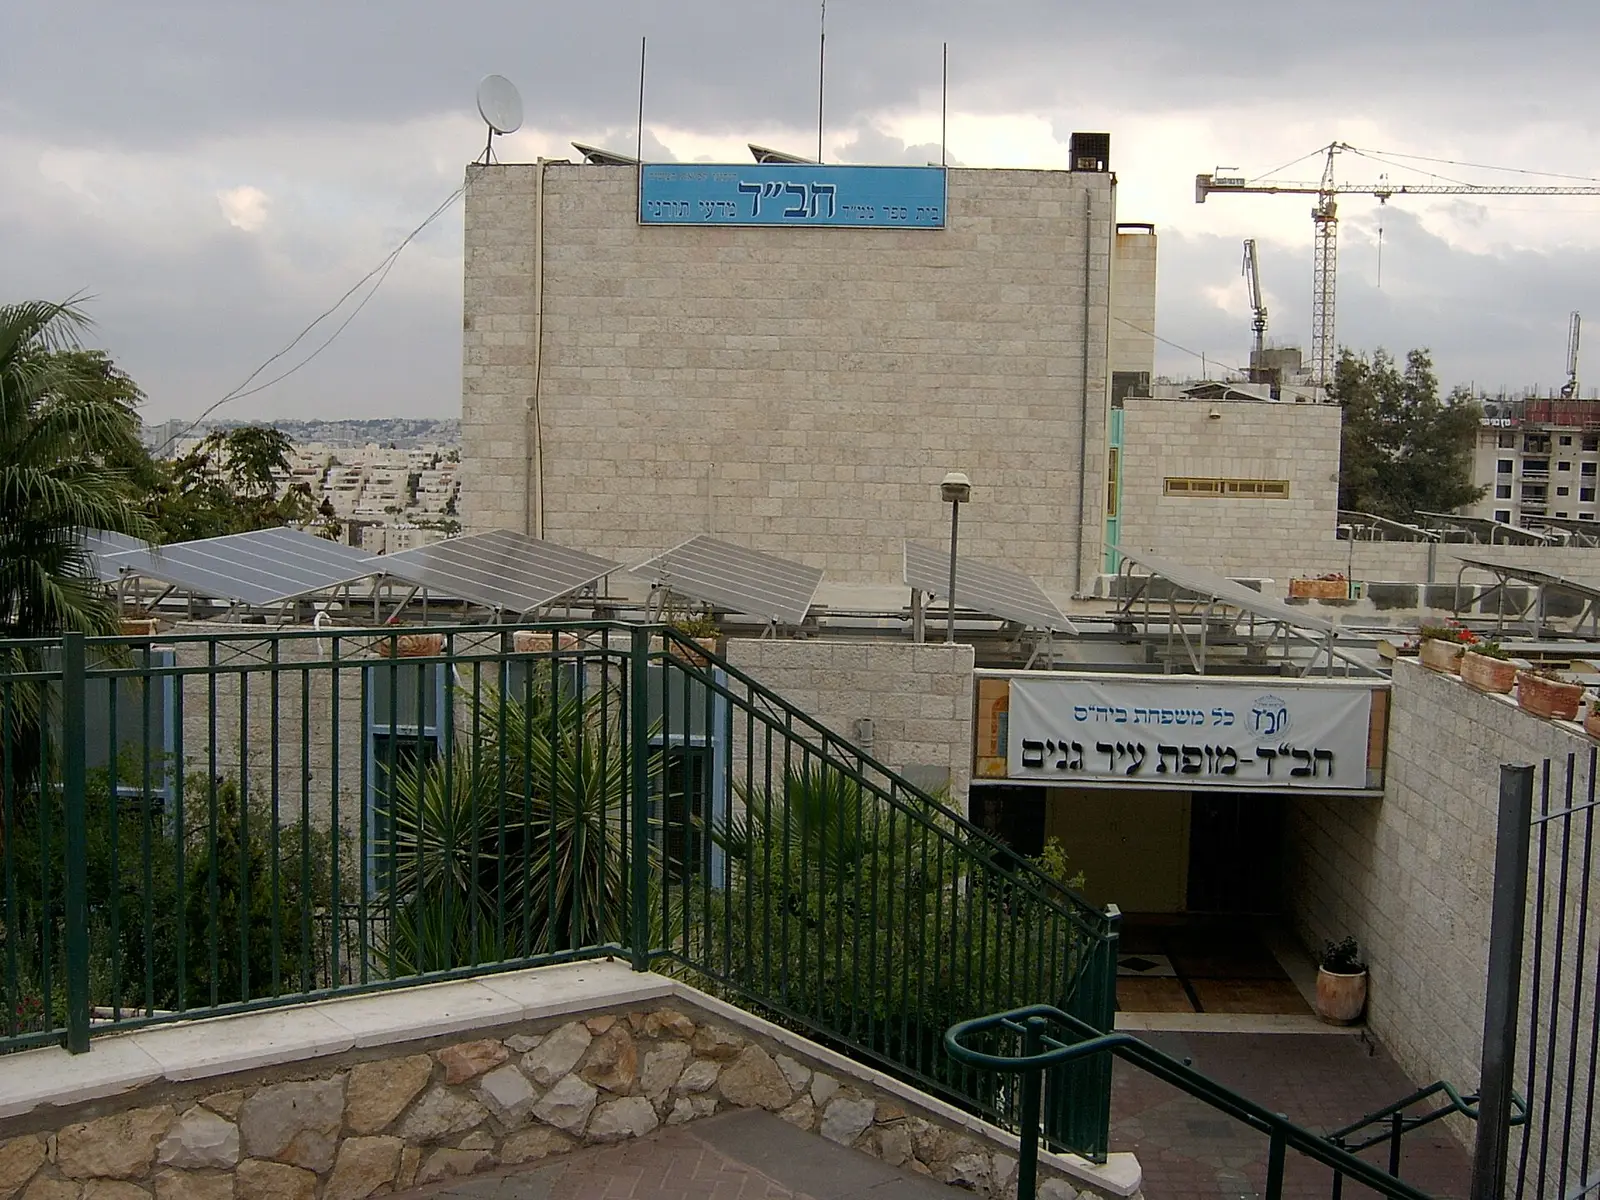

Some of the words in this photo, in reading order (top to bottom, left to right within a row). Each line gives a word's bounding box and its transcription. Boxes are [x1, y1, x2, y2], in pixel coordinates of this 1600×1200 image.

[647, 200, 691, 217] תורני
[698, 200, 737, 219] מדעי
[882, 204, 908, 220] ספר
[915, 205, 940, 221] בית
[1133, 706, 1205, 726] משפחת
[1211, 707, 1236, 726] כל
[1022, 738, 1084, 770] גנים
[1096, 740, 1146, 776] עיר
